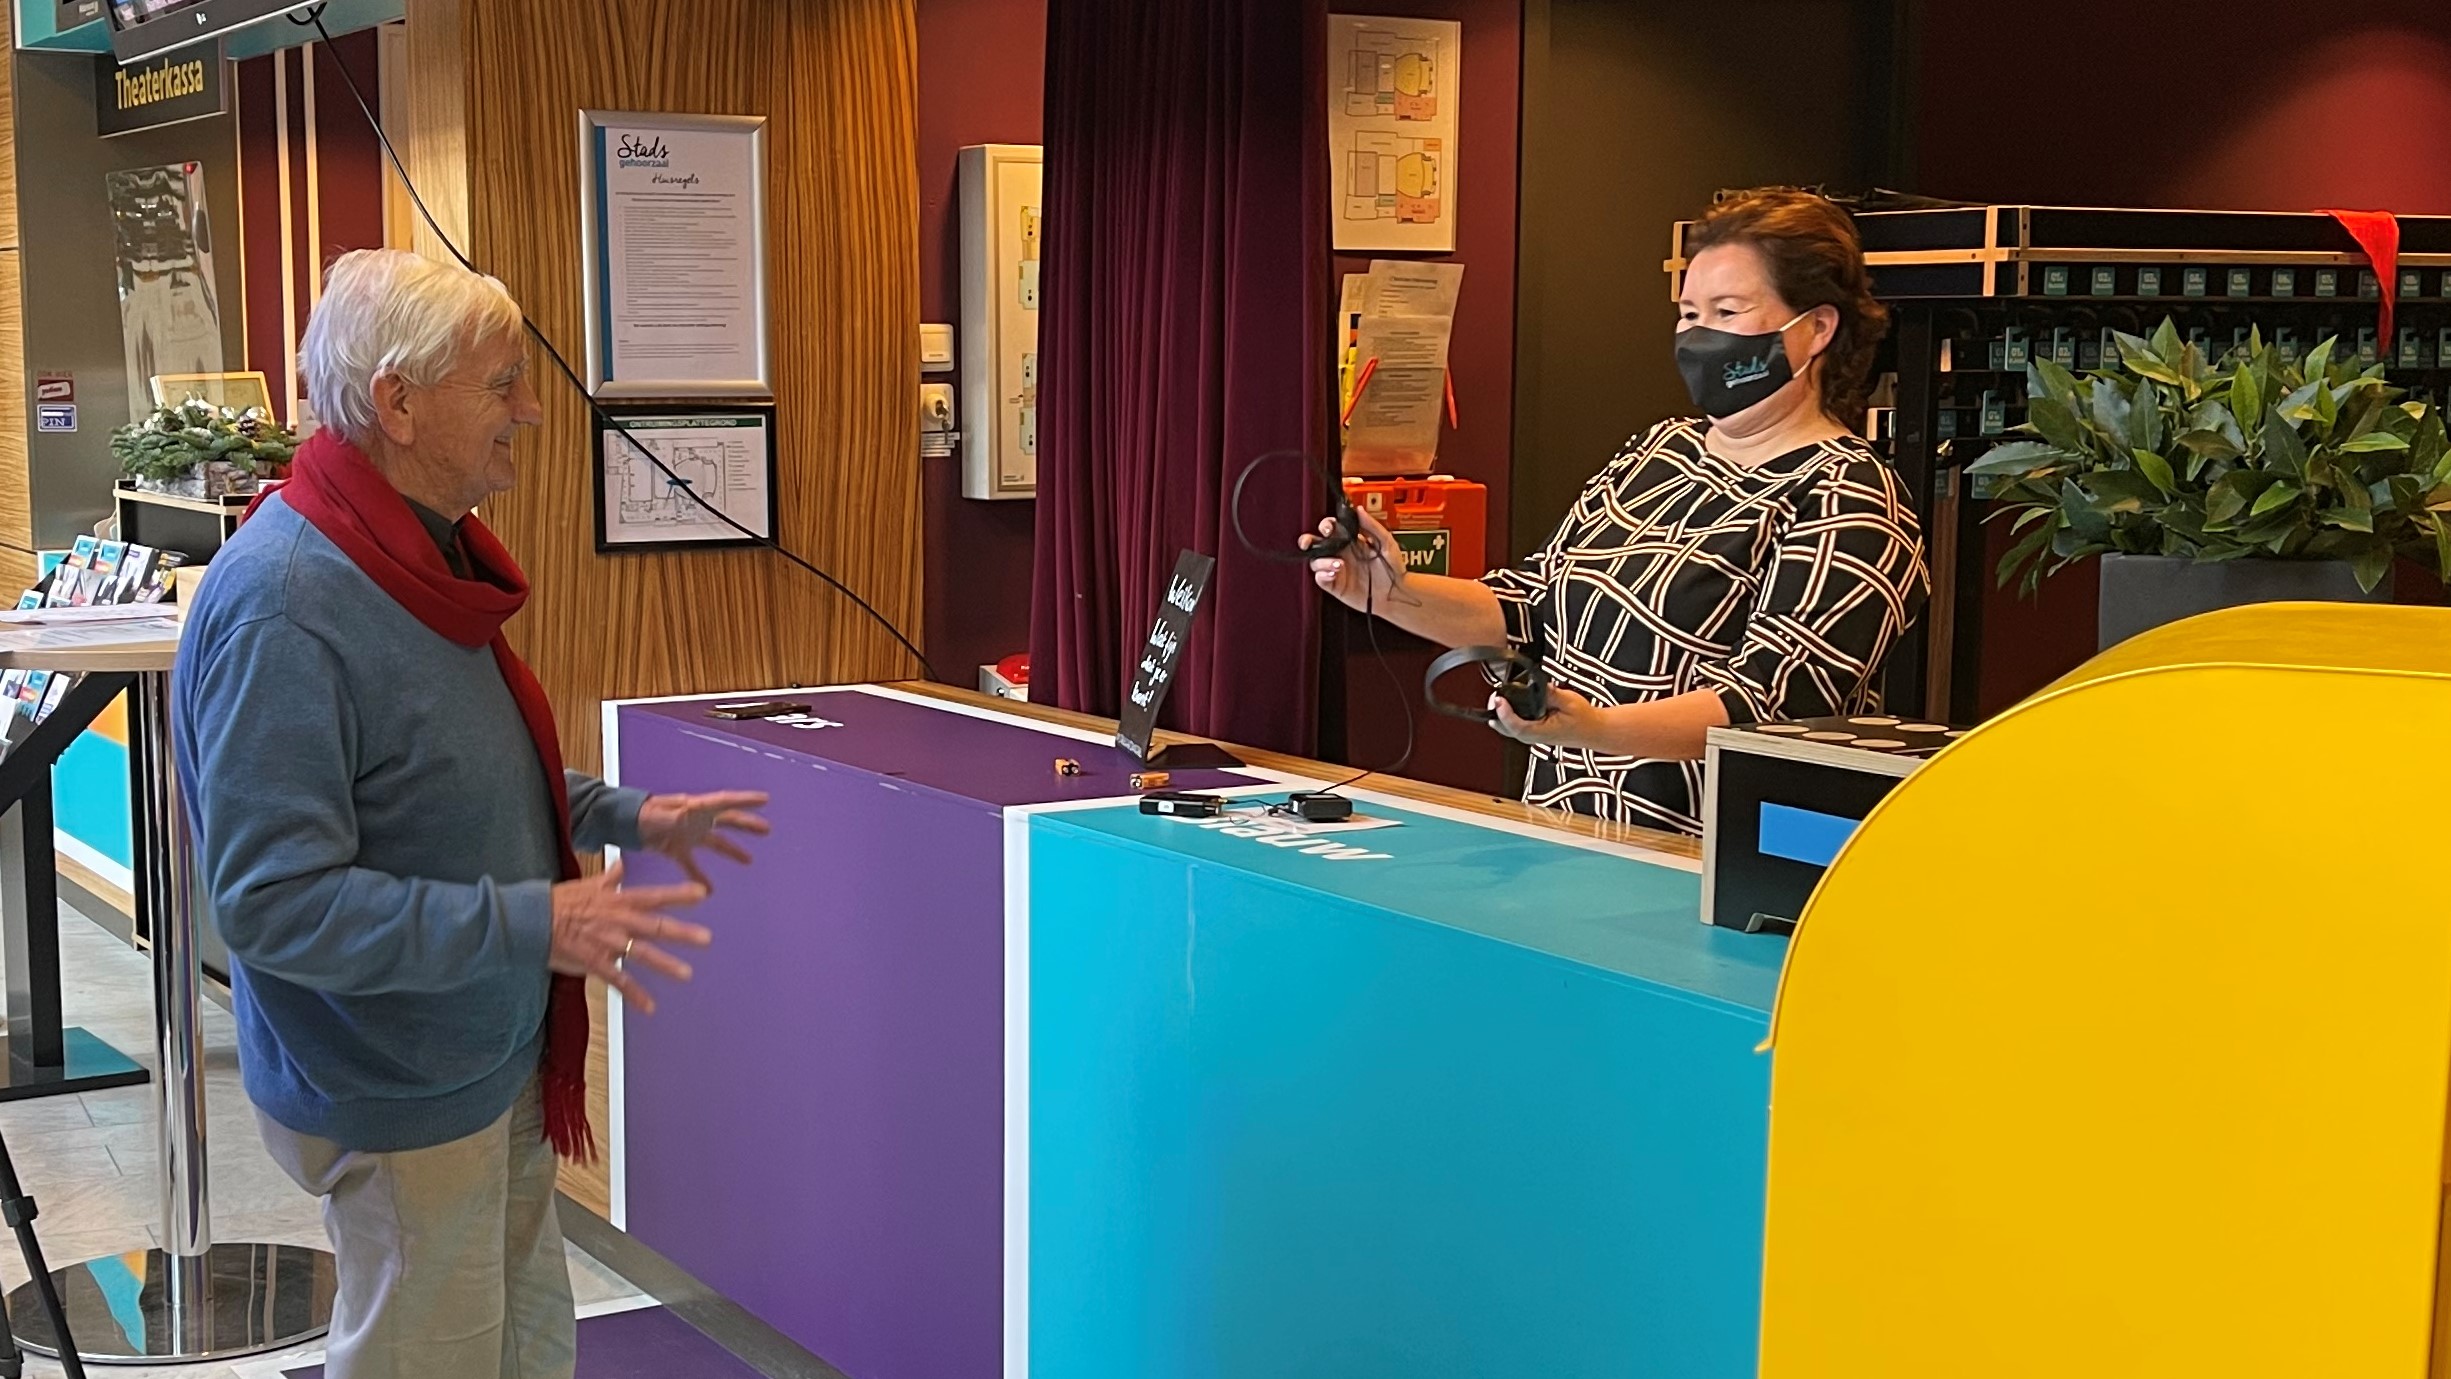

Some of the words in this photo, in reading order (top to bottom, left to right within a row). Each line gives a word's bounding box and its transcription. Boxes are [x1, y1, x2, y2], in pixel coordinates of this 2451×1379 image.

[115, 57, 204, 110] Theaterkassa
[617, 133, 670, 159] Stads
[619, 158, 670, 169] gehoorzaal
[42, 417, 66, 427] PIN
